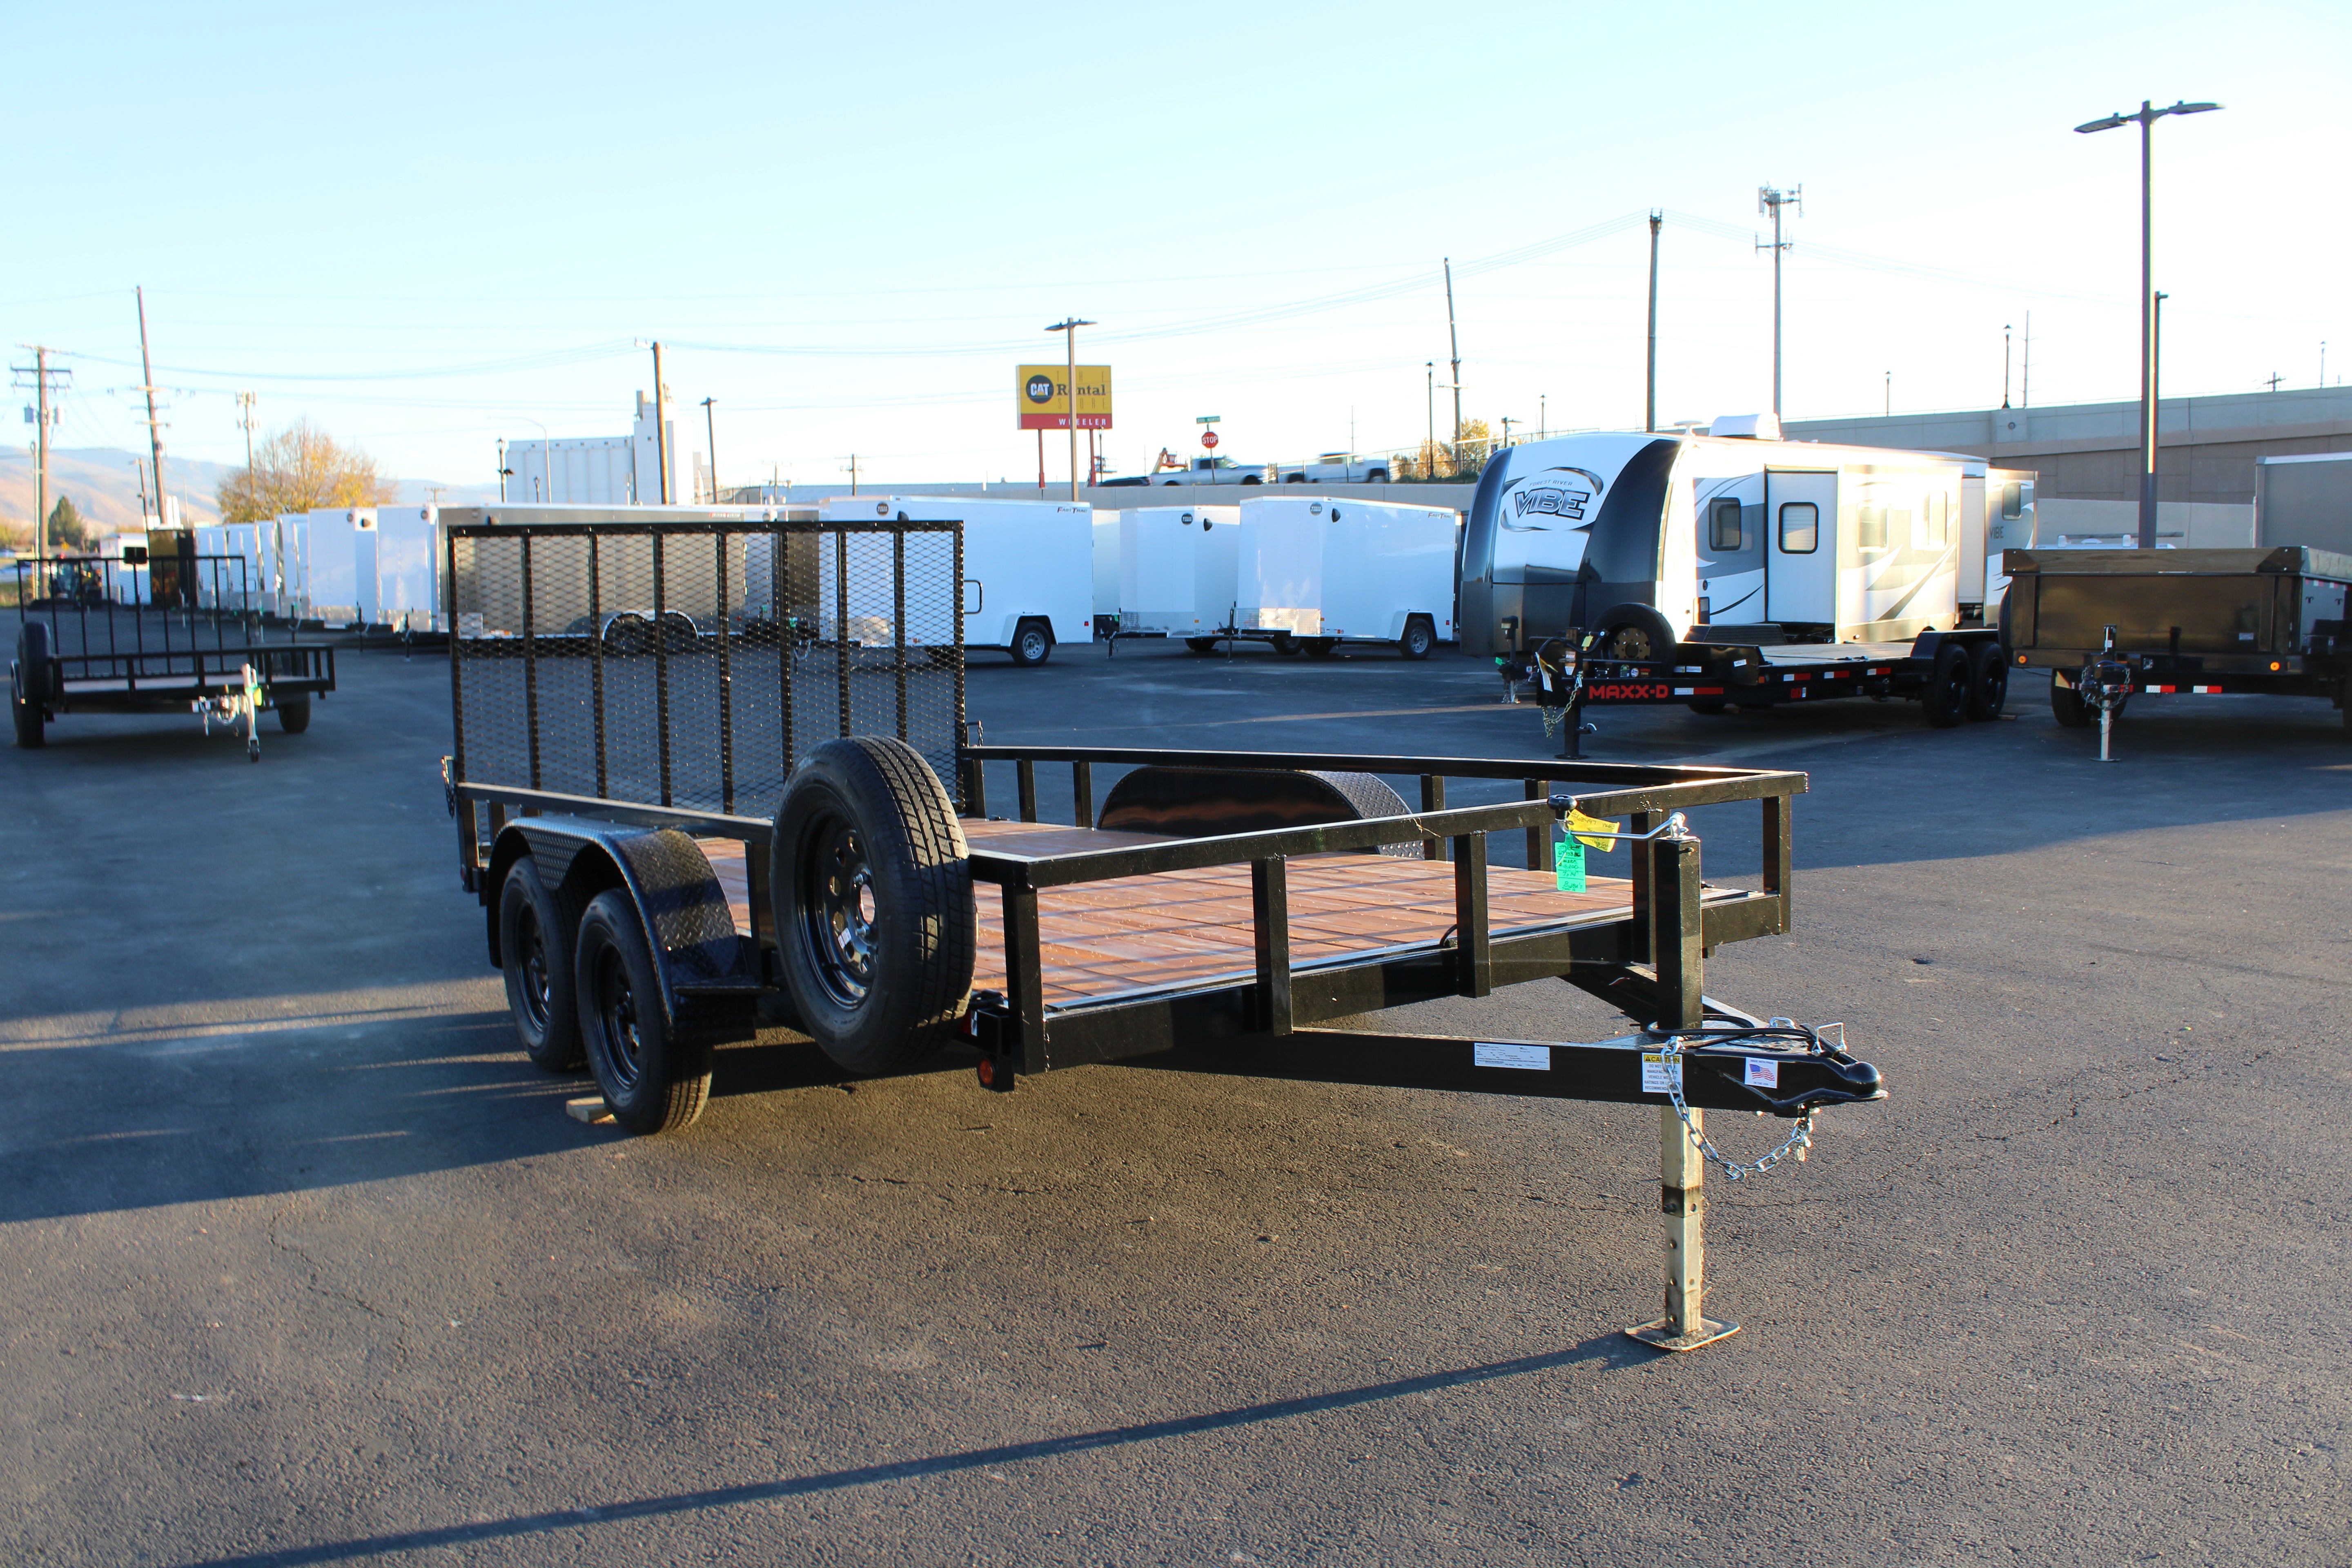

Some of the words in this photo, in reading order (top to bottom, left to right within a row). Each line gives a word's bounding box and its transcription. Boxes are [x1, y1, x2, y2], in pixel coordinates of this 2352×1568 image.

[1056, 370, 1105, 382] THE
[1030, 383, 1050, 396] CAT
[1056, 383, 1106, 396] Rntal
[1058, 397, 1107, 409] SORE
[1202, 435, 1217, 445] STOP
[1515, 487, 1590, 521] VIBE
[1989, 526, 2004, 539] VIBE
[1589, 685, 1668, 699] MAXX-D
